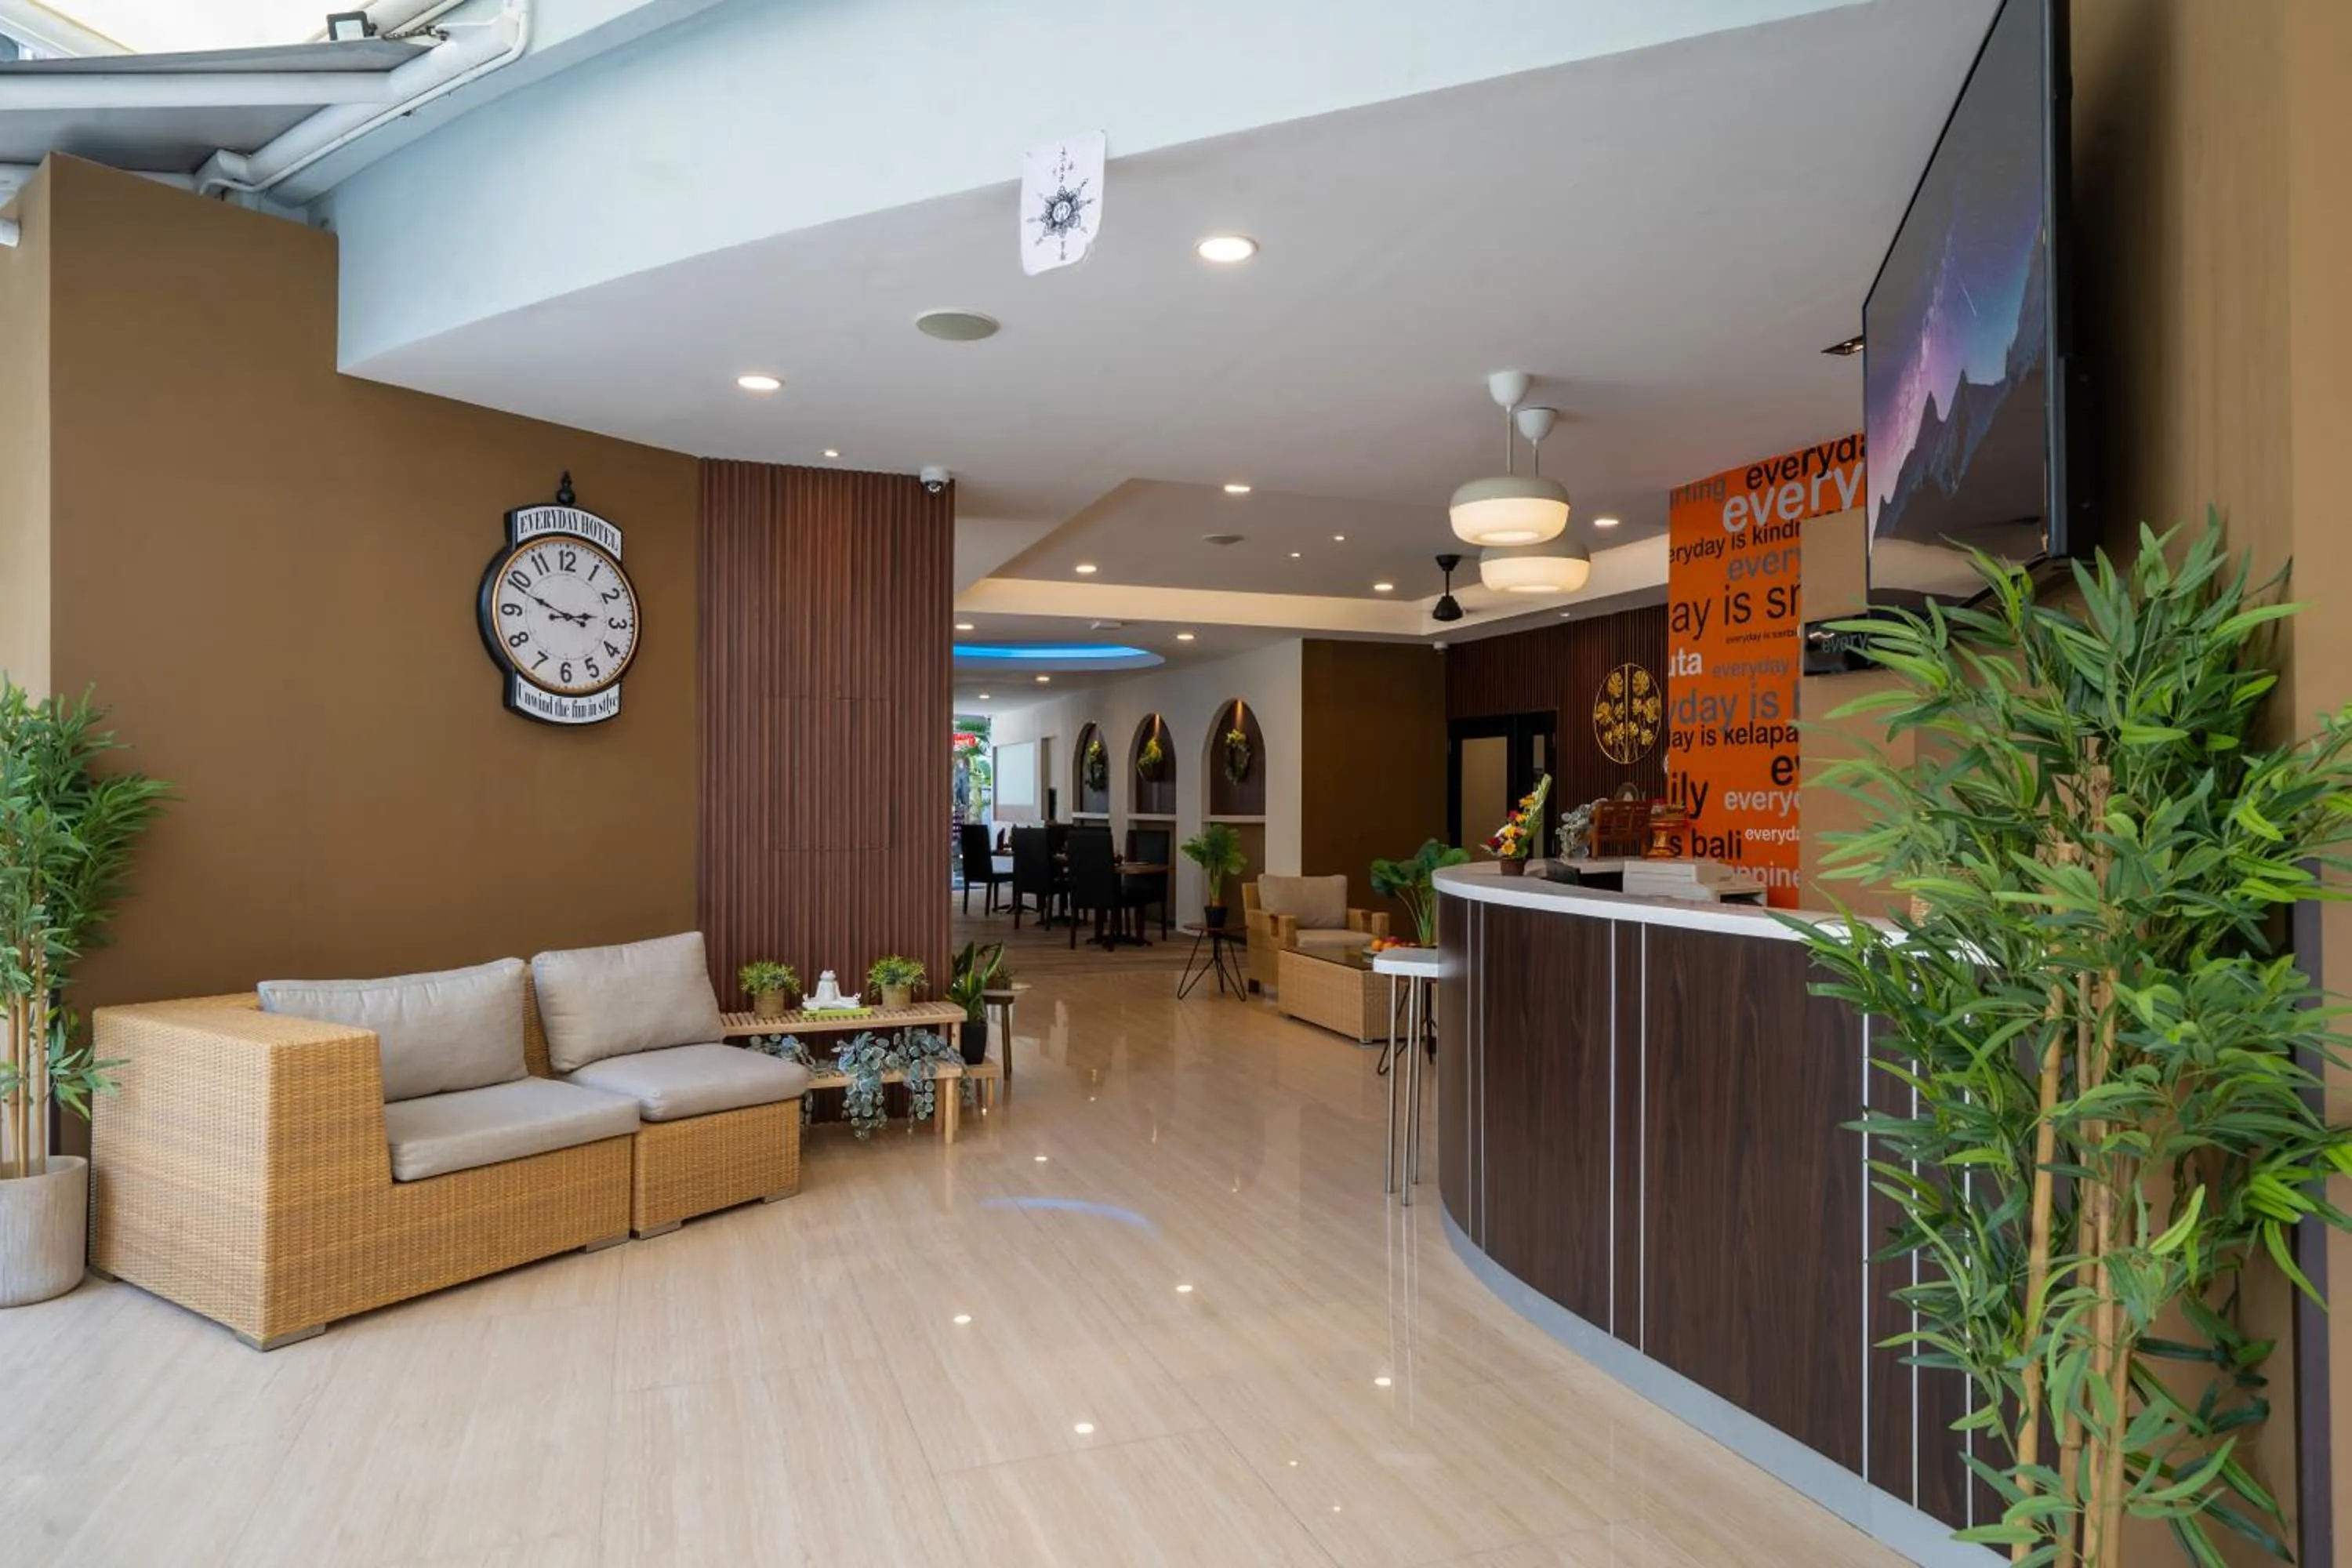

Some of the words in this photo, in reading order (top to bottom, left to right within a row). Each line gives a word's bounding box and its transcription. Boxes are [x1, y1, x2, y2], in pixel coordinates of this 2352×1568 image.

[520, 510, 579, 534] EVERYDAY
[581, 514, 619, 551] HOTEL
[1731, 532, 1746, 550] is
[532, 553, 550, 575] 11
[559, 550, 576, 572] 12
[508, 571, 531, 593] 10
[588, 564, 599, 581] 1
[601, 588, 620, 604] 2
[1724, 584, 1751, 626] is
[502, 603, 523, 617] 9
[608, 617, 627, 630] 3
[510, 631, 529, 648] 8
[603, 641, 620, 658] 4
[531, 651, 549, 670] 7
[584, 657, 600, 678] 5
[1712, 658, 1788, 681] everyday
[561, 662, 572, 683] 6
[518, 682, 553, 715] Unwind
[554, 697, 570, 717] the
[572, 699, 586, 718] fun
[587, 698, 597, 717] in
[1750, 681, 1779, 720] is
[1700, 724, 1716, 746] is
[1725, 721, 1798, 750] kelapa
[1692, 828, 1742, 859] bali
